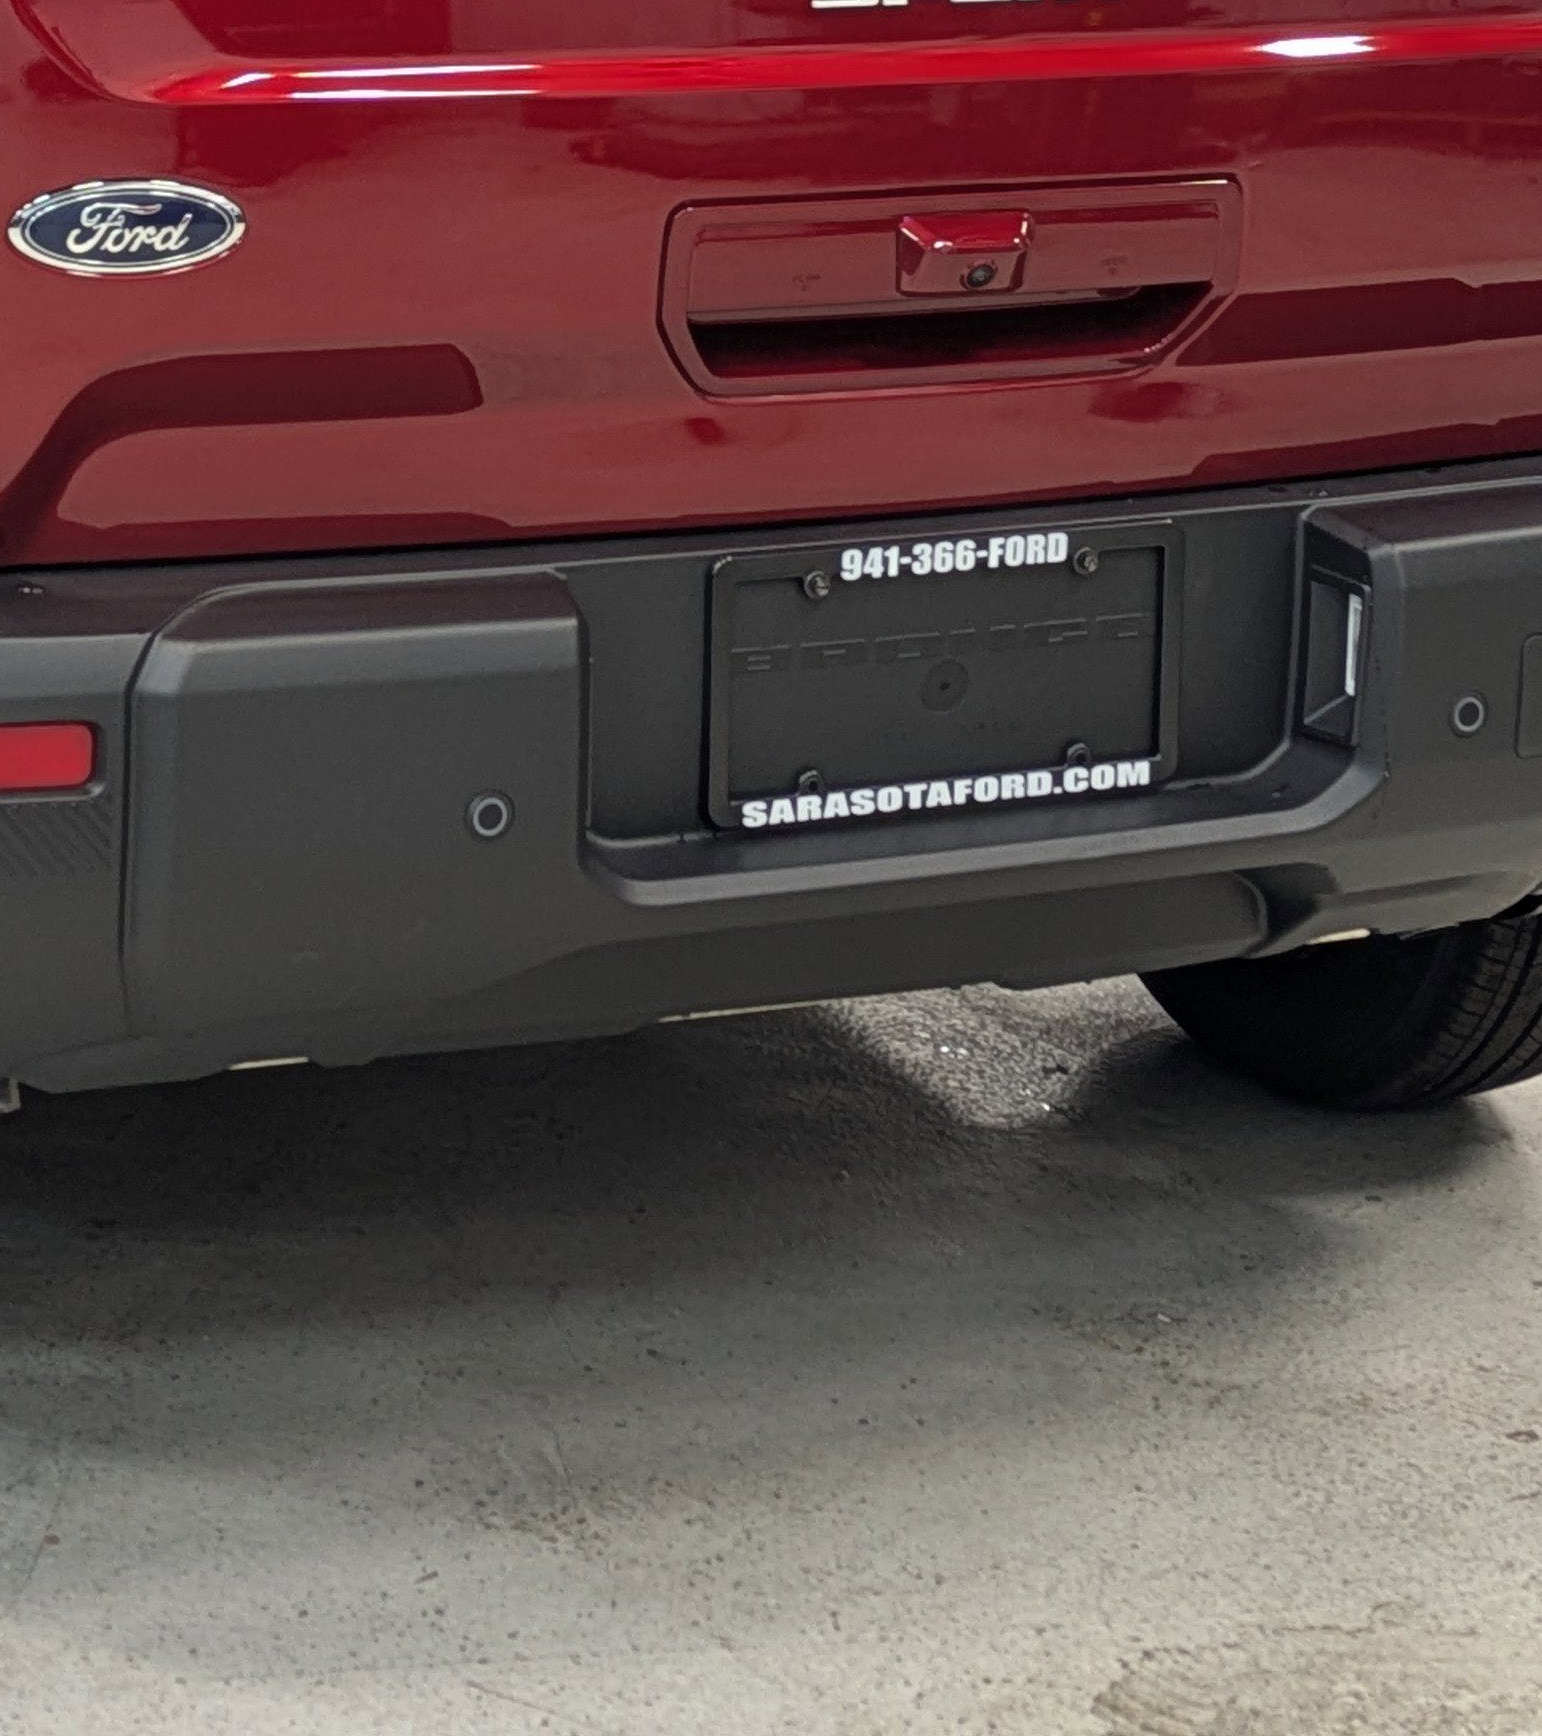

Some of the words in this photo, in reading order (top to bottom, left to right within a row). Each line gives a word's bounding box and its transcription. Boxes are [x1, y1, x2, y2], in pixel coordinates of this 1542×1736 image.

[66, 201, 193, 254] Ford
[840, 532, 1069, 582] 941-366-FORD
[741, 759, 1152, 830] SARASOTAFORD.COM
